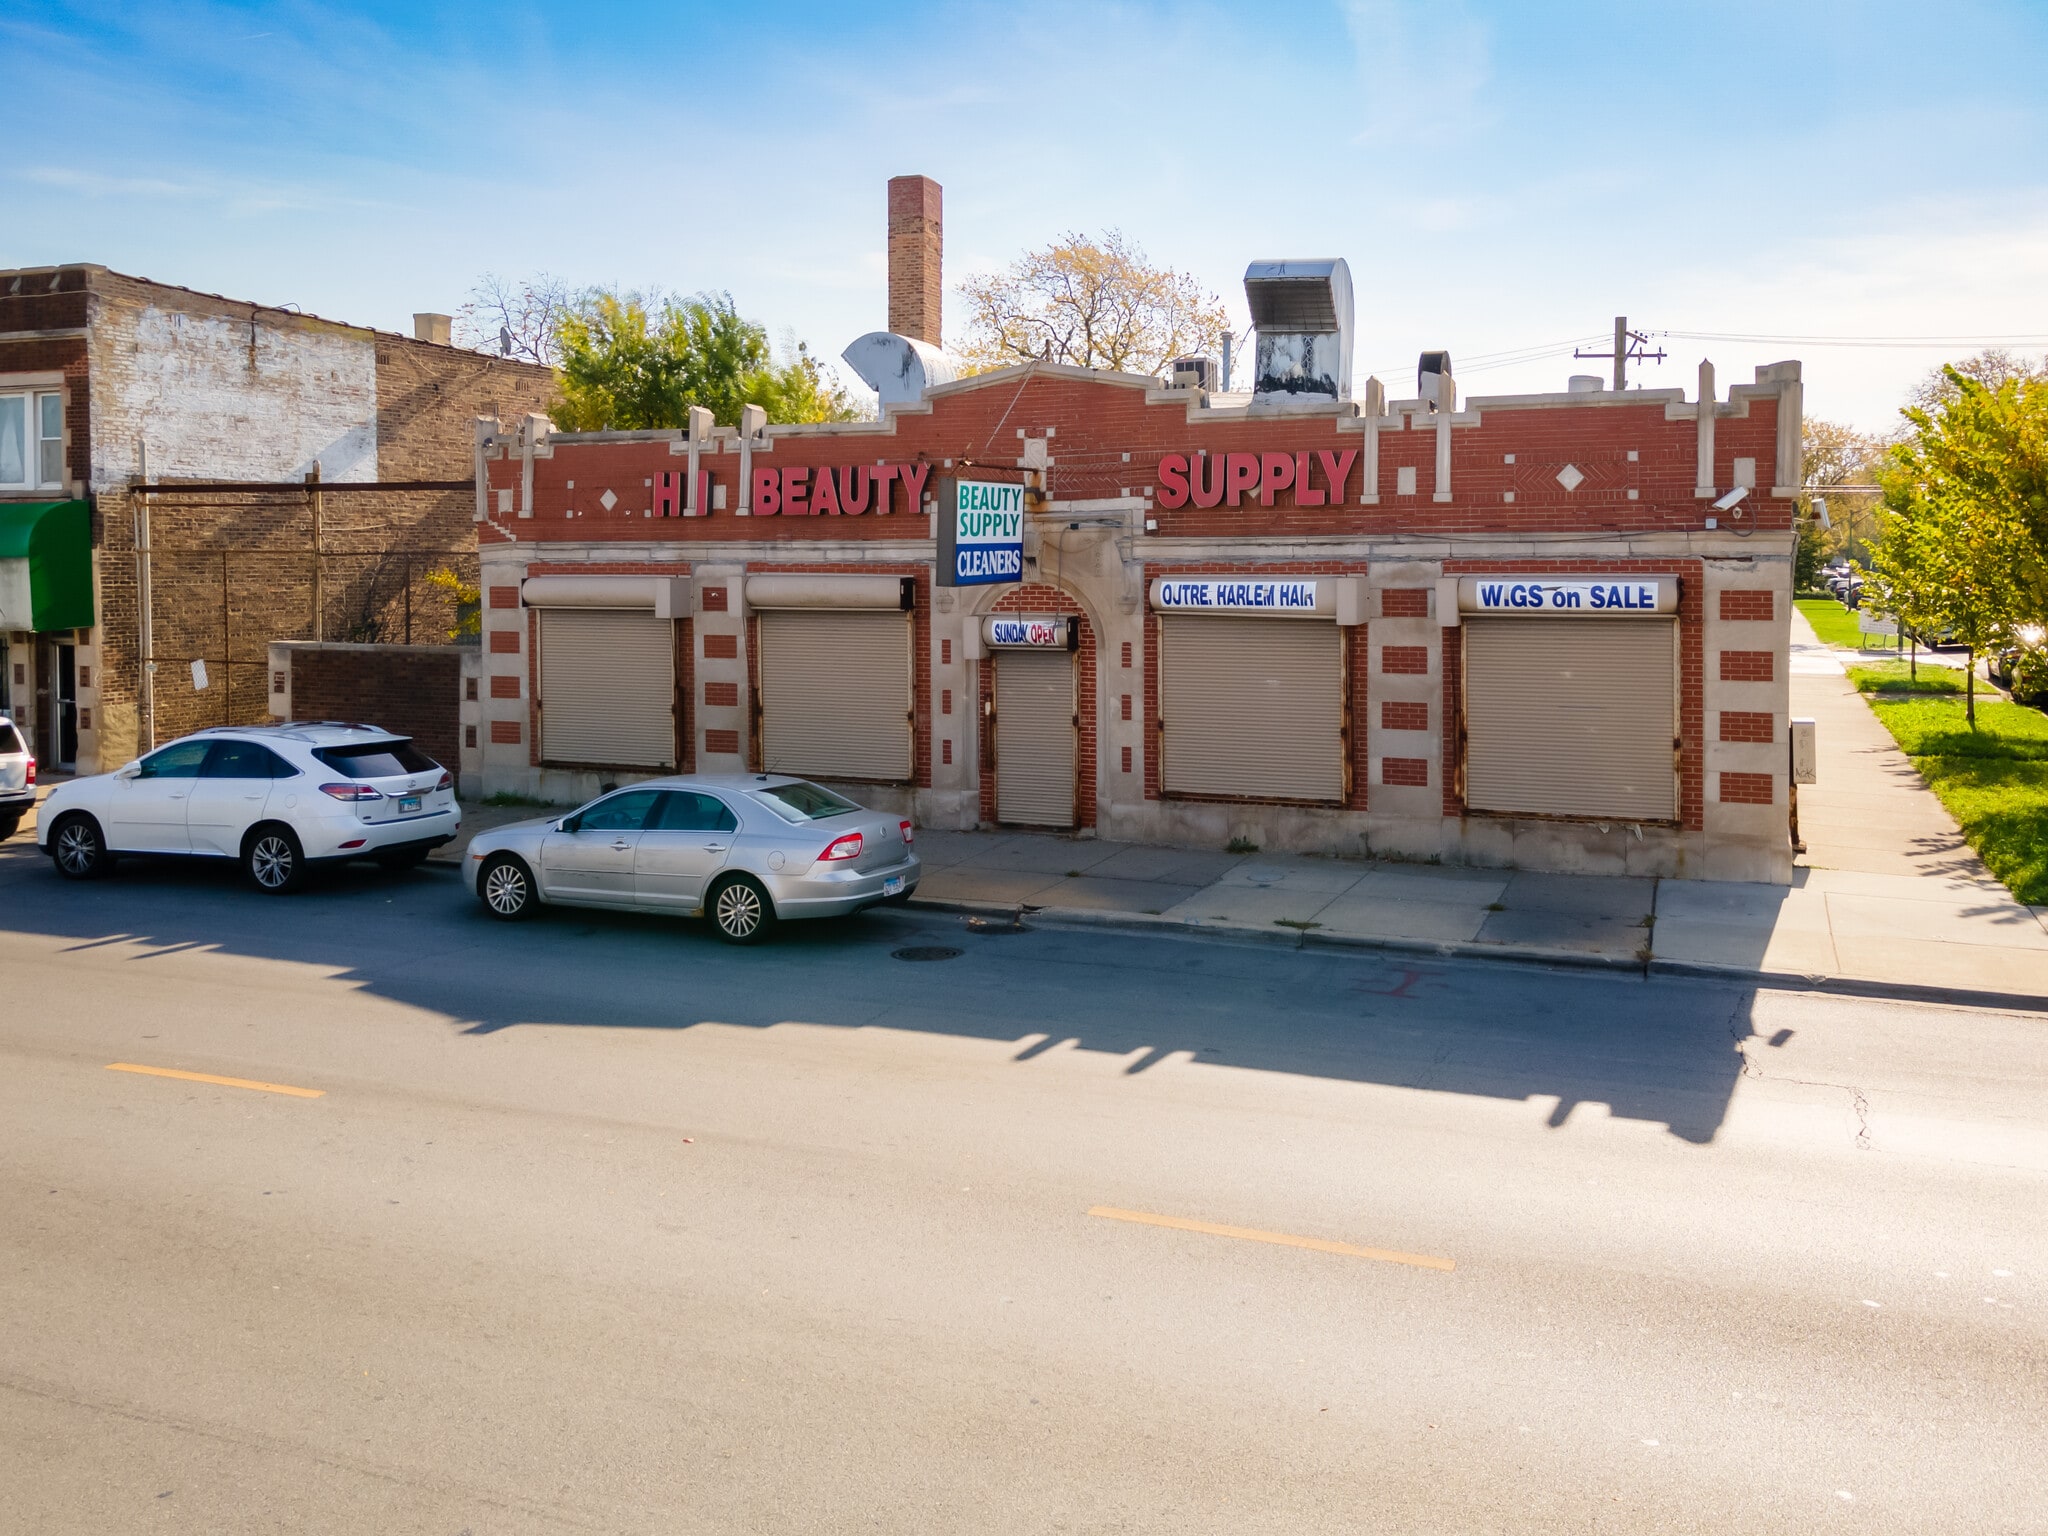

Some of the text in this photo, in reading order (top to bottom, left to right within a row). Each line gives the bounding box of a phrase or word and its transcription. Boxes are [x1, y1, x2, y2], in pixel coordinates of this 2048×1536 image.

[654, 450, 1358, 517] HI BEAUTY SUPPLY
[959, 485, 1021, 511] BEAUTY
[959, 512, 1020, 537] SUPPLY
[957, 550, 1020, 577] CLEANERS
[1217, 584, 1275, 606] HARLEM
[1481, 585, 1655, 608] WGS on SALE
[994, 623, 1056, 643] SUNDAY OPEN
